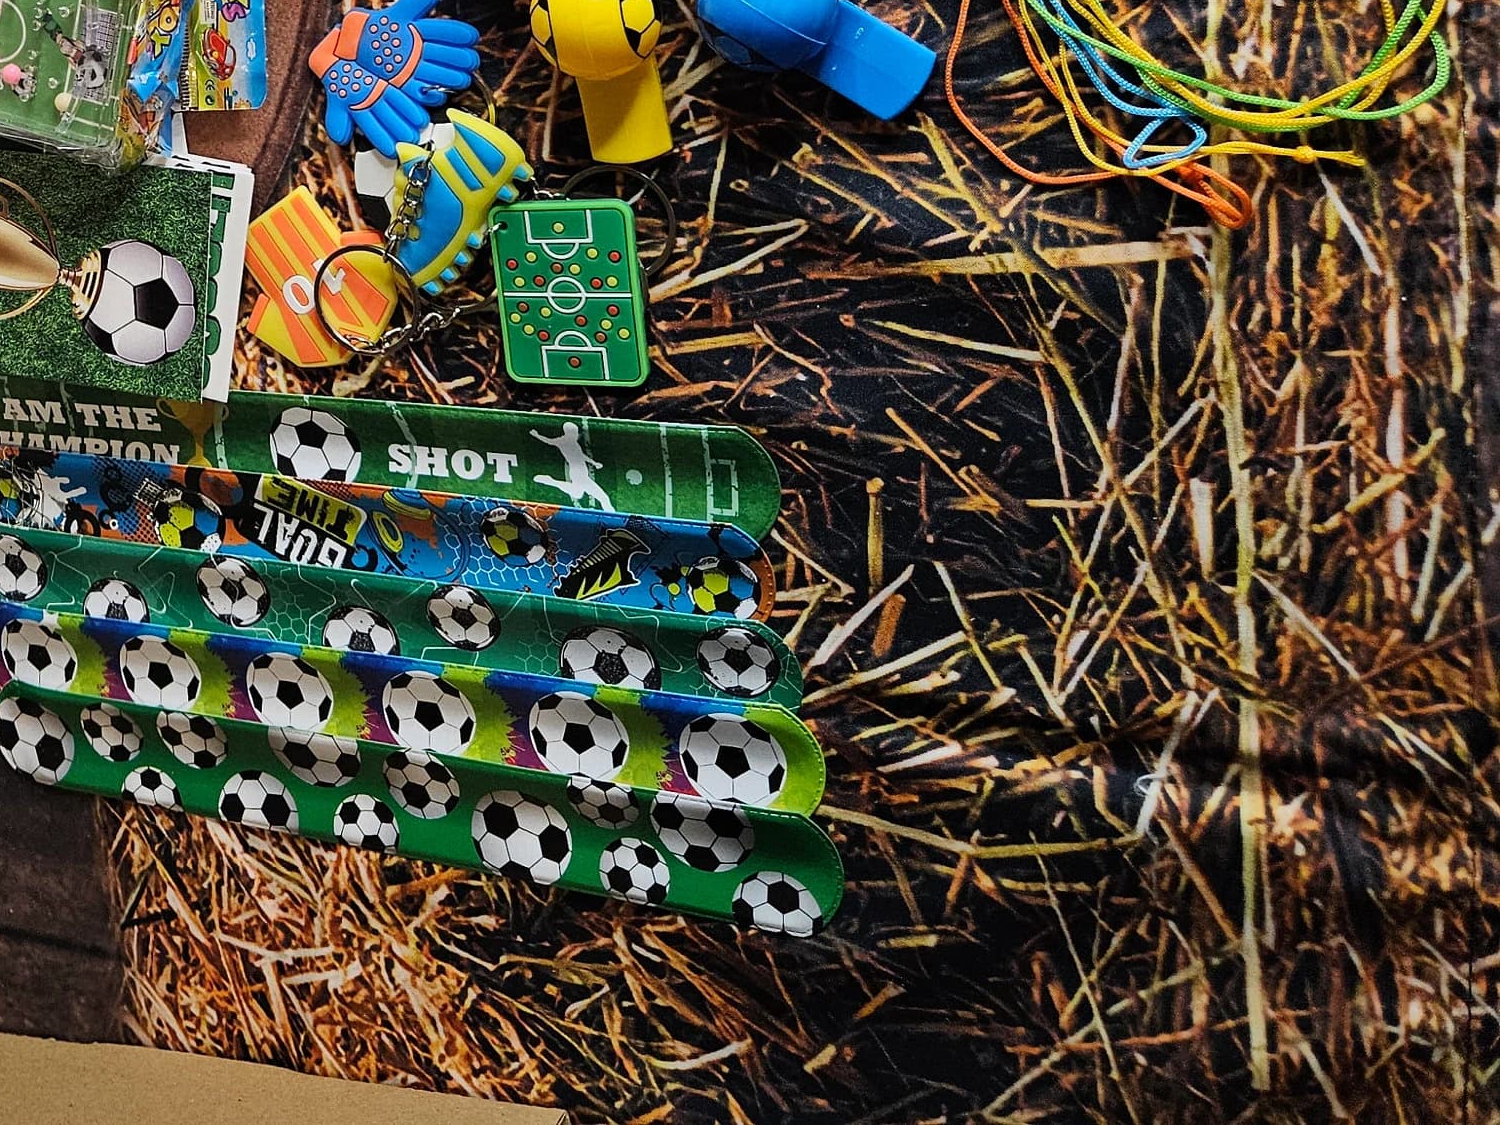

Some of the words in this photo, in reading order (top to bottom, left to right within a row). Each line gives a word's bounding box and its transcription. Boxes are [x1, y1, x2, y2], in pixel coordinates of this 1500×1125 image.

[2, 397, 67, 424] AM
[74, 402, 162, 432] THE
[387, 443, 518, 484] SHOT
[251, 501, 348, 568] GOAL
[269, 475, 356, 542] TIME
